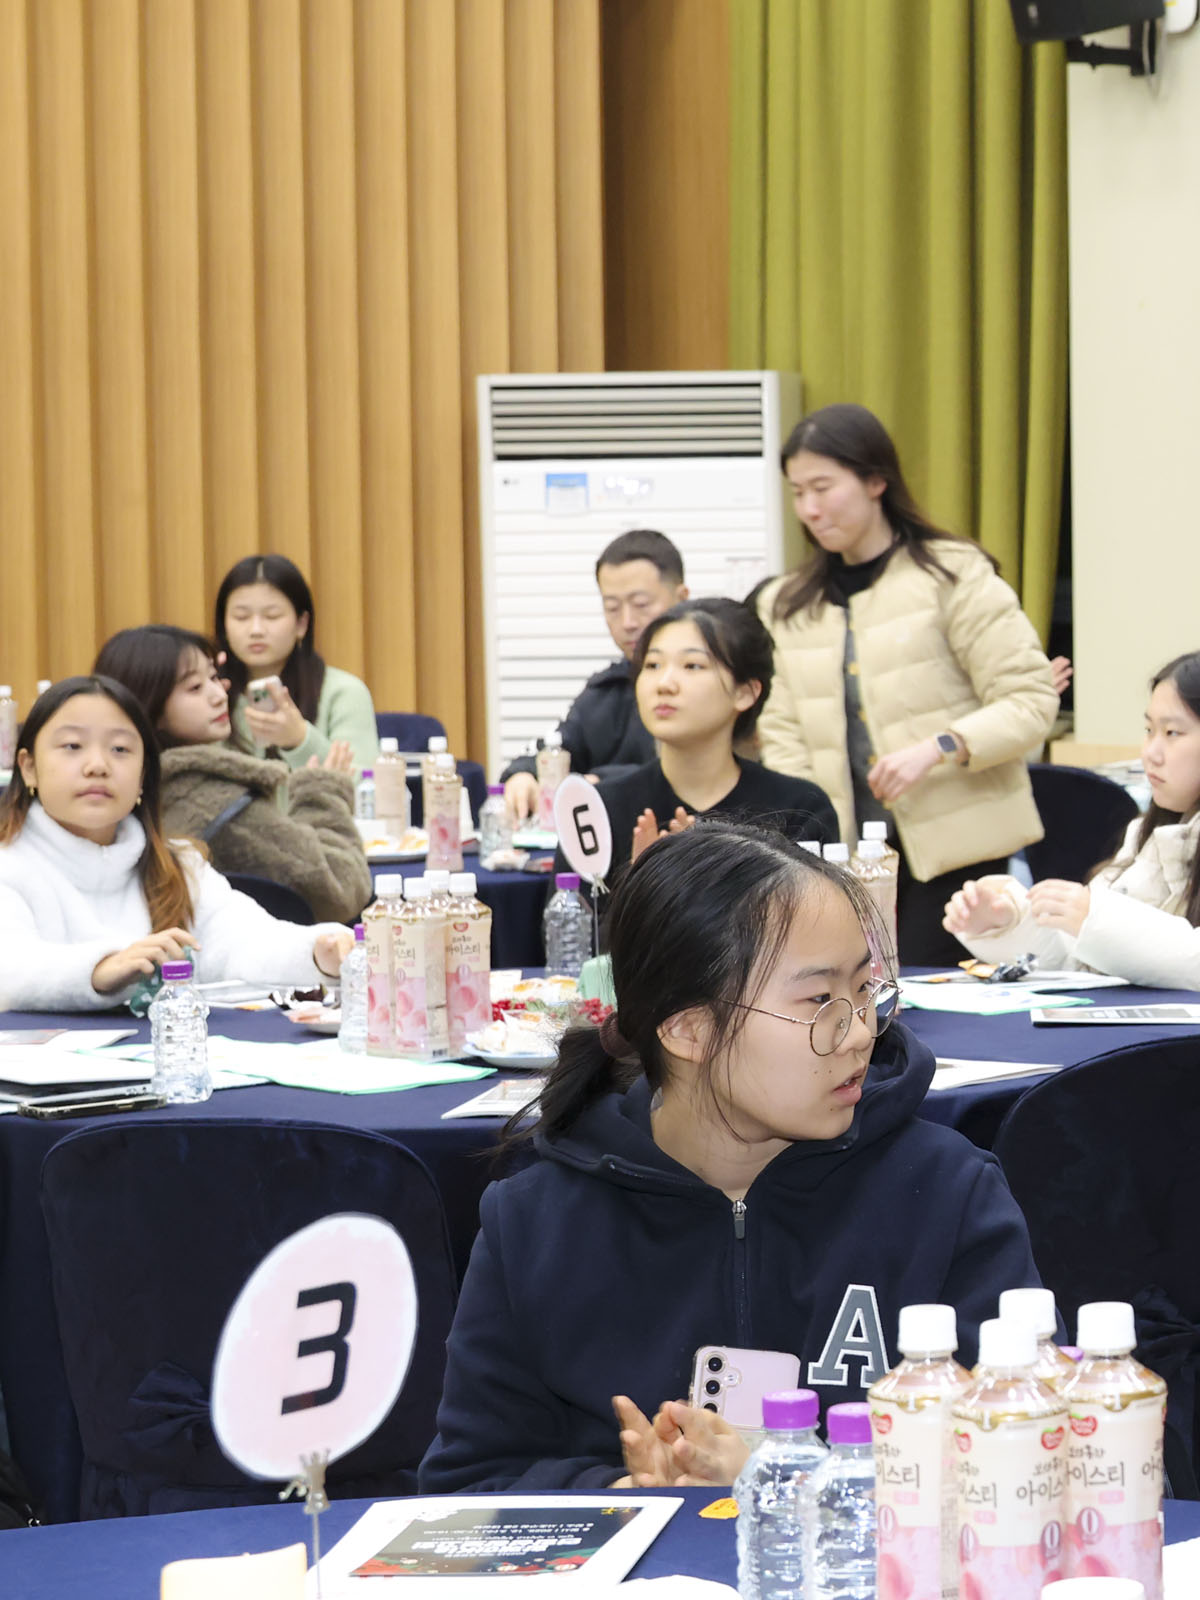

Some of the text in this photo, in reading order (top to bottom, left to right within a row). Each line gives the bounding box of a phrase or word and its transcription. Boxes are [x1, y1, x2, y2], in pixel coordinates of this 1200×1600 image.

[572, 804, 599, 856] 6
[280, 1281, 357, 1415] 3
[808, 1284, 891, 1388] A
[876, 1458, 920, 1490] 이스티
